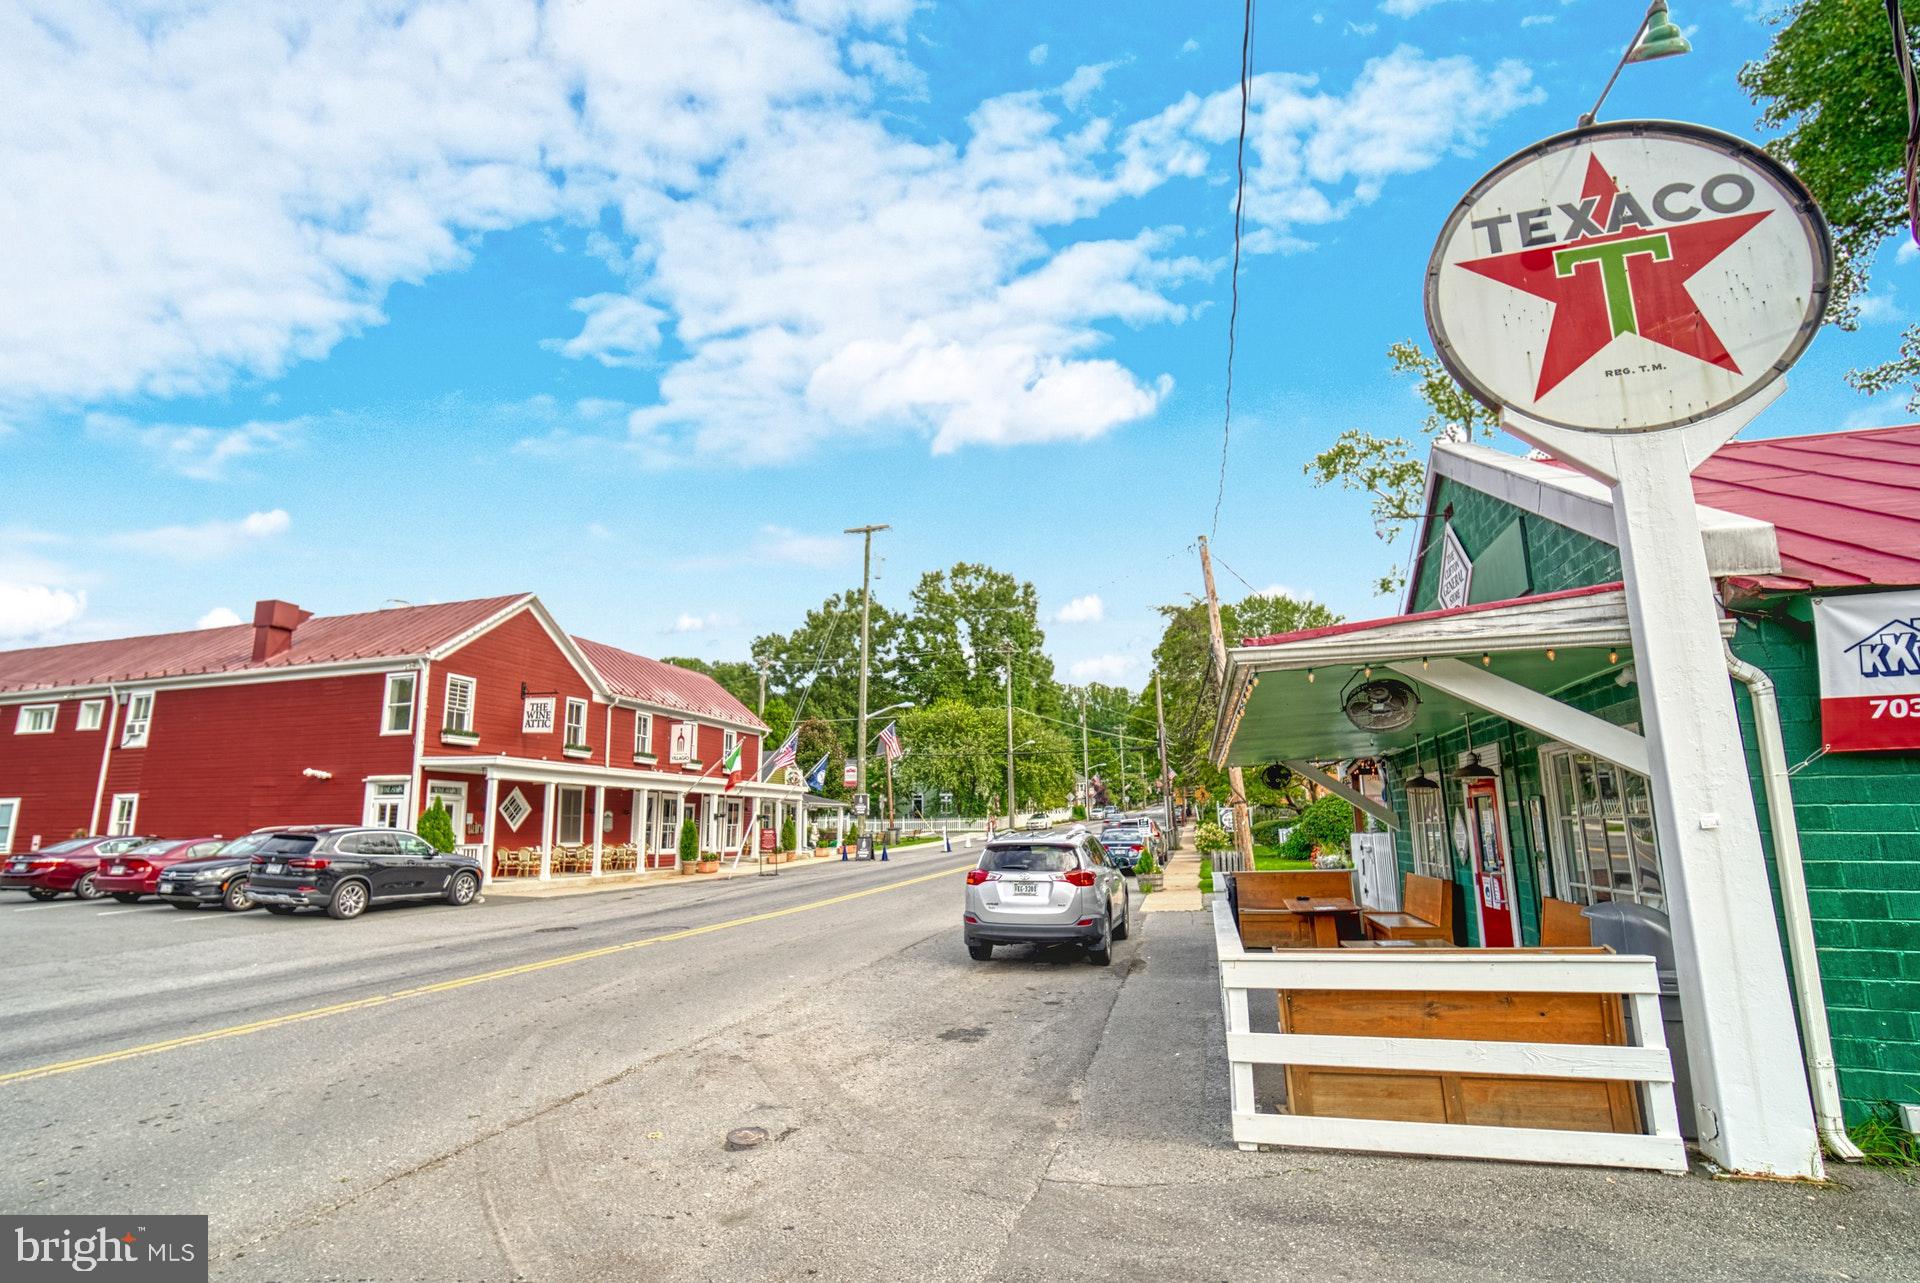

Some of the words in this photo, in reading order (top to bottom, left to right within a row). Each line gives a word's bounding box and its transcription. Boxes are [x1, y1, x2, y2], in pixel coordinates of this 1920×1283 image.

[1471, 173, 1755, 254] TEXACO
[1552, 232, 1674, 341] T
[1604, 367, 1636, 377] REG.
[1443, 570, 1464, 596] GENERAL
[530, 702, 549, 711] THE
[526, 711, 552, 720] WINE
[524, 719, 551, 728] ATTIC
